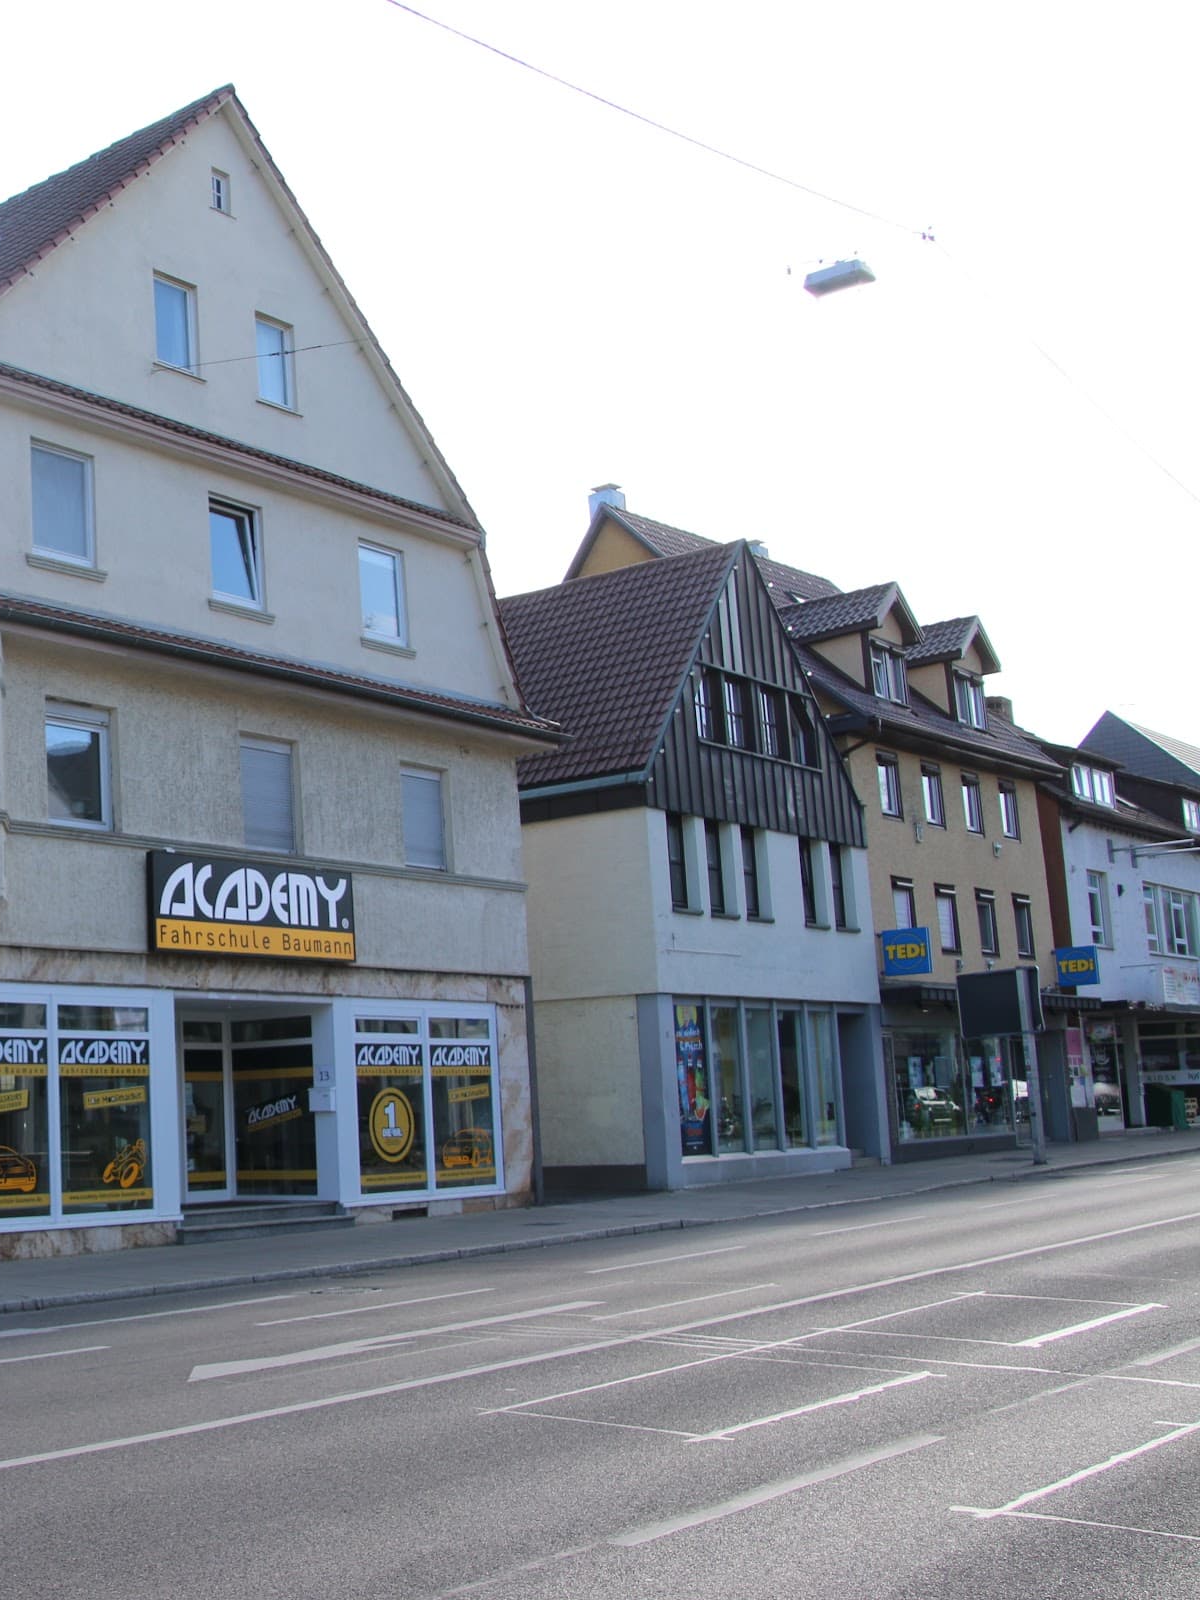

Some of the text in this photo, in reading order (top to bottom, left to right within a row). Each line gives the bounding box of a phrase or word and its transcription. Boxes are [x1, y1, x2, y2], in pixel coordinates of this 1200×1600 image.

[160, 924, 351, 955] Fahrschule Baumann
[886, 943, 926, 960] TEDi
[1059, 960, 1094, 973] TEDi
[320, 1071, 330, 1081] 13
